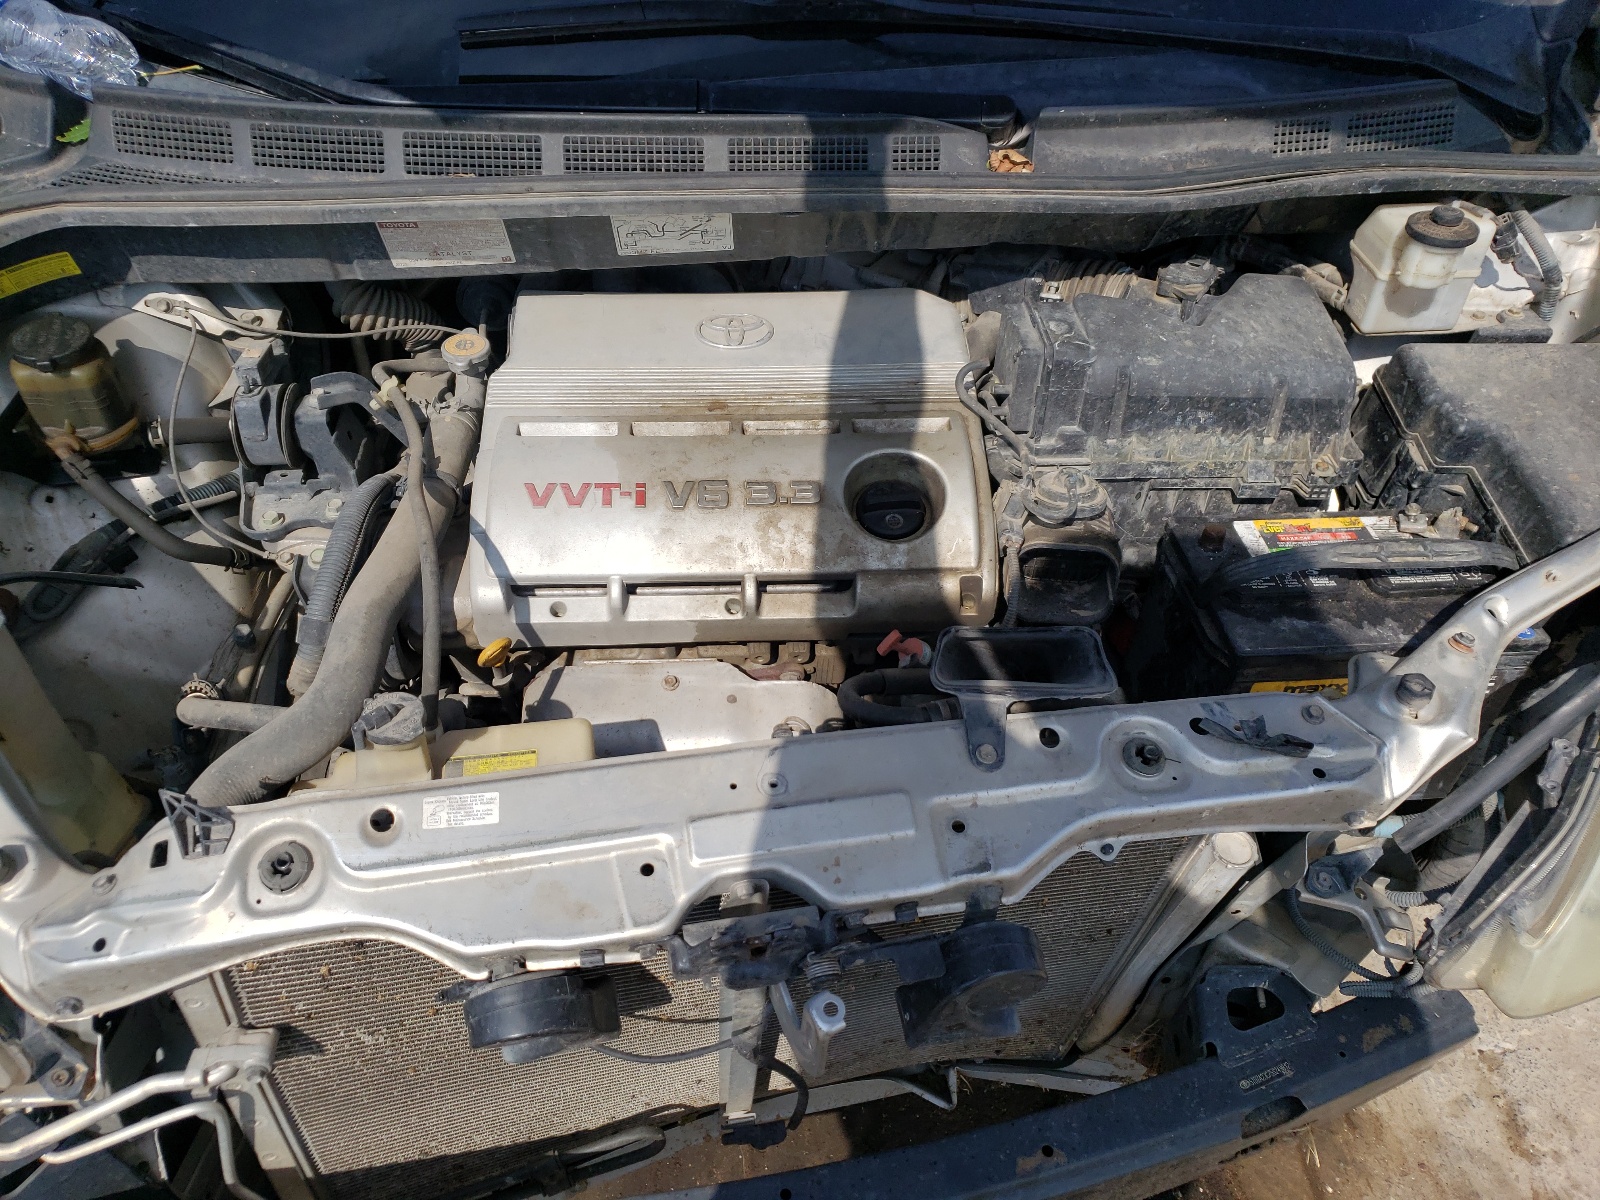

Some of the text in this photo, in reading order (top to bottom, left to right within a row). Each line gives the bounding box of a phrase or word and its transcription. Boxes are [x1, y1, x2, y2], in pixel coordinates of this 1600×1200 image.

[523, 480, 822, 510] VVT-i V6 3.3
